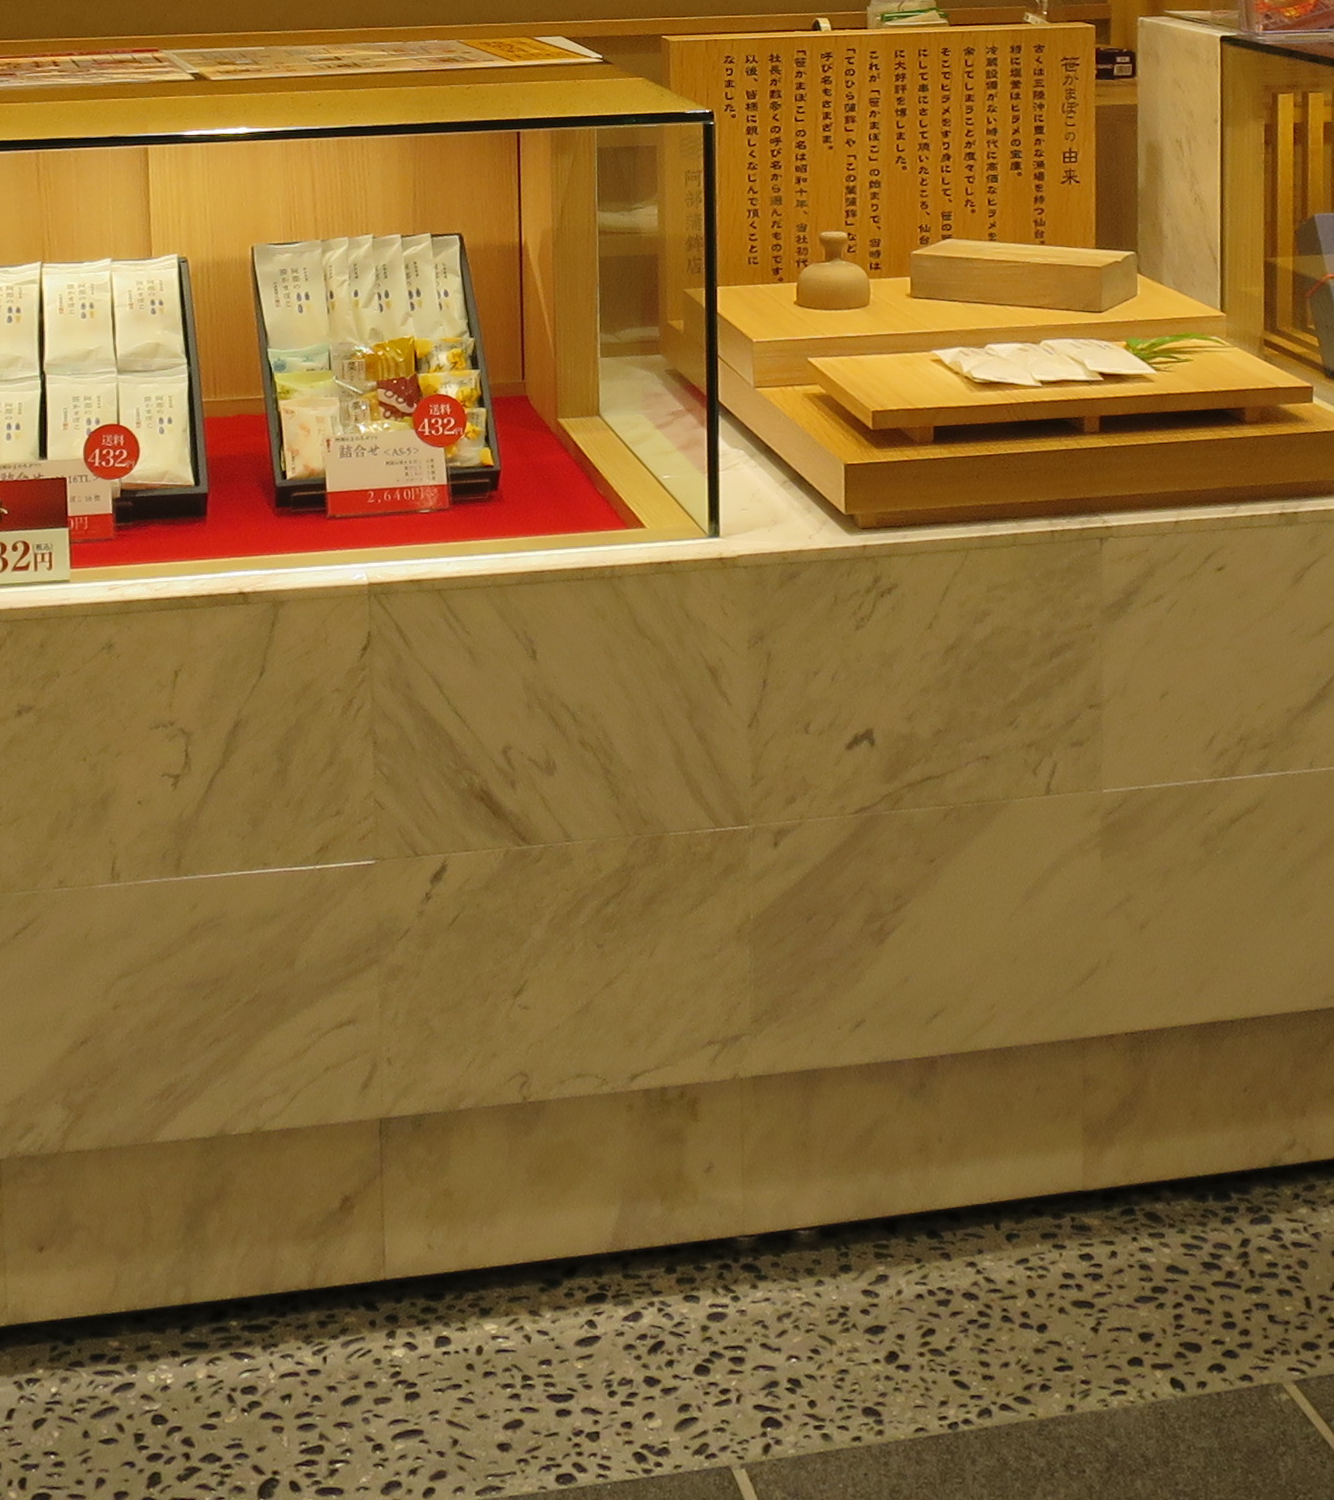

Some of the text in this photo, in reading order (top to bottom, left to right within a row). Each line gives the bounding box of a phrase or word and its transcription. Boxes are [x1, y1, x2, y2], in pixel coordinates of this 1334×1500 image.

[723, 55, 737, 119] なりました。
[1060, 56, 1081, 185] 笹かまぼこの由来
[428, 403, 452, 416] 送料
[101, 434, 125, 446] 送料
[339, 444, 380, 459] 詰合せ
